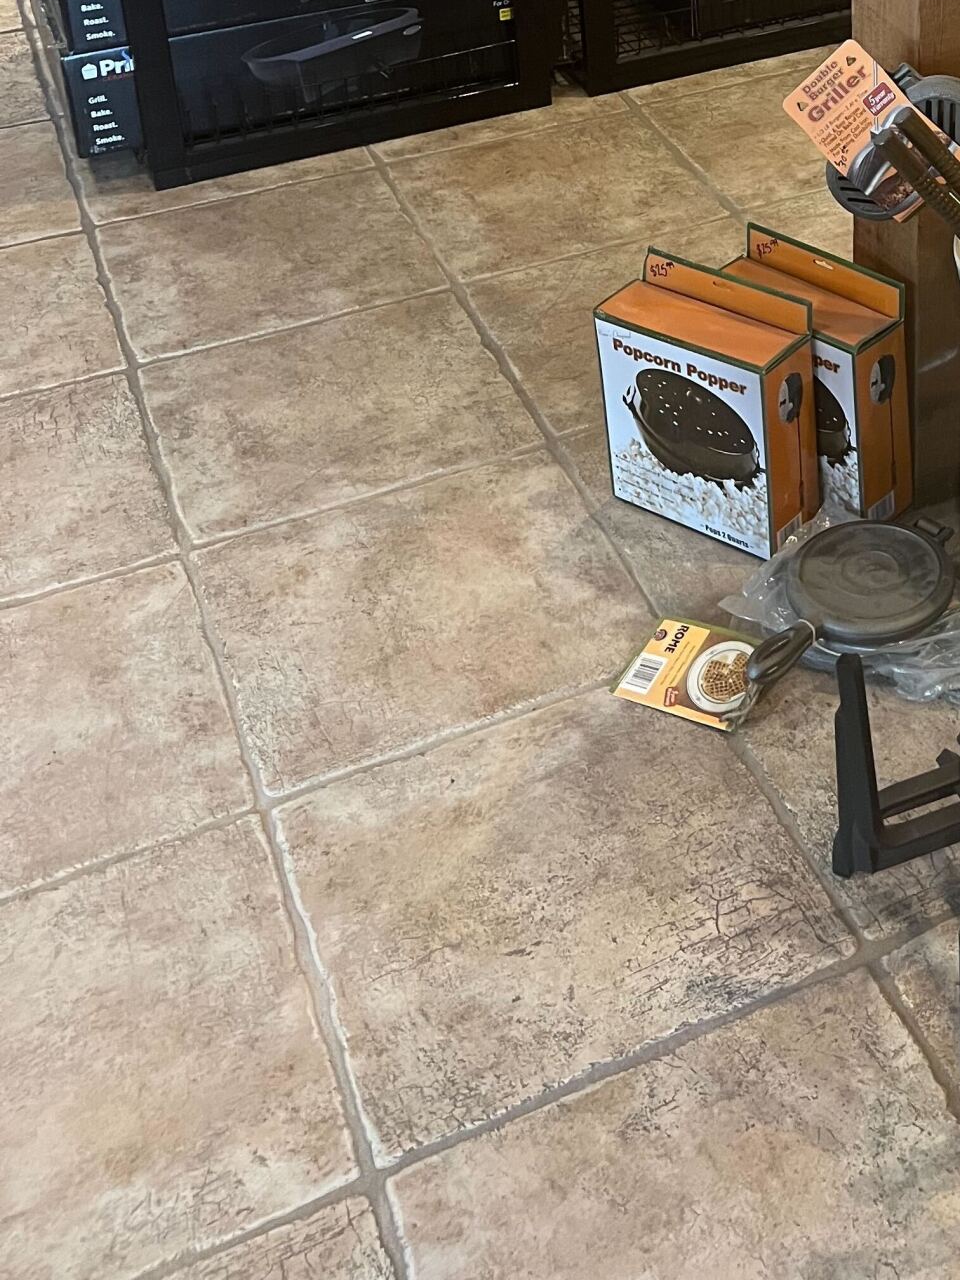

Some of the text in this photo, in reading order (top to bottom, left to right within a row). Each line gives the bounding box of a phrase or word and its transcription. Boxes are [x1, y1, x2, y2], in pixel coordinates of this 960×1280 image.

[80, 3, 104, 12] Bake.
[83, 17, 109, 27] Roast.
[86, 30, 116, 41] Smoke.
[802, 61, 838, 94] Double
[808, 68, 845, 101] Burger
[808, 66, 867, 122] Griller
[869, 94, 876, 105] 5
[88, 95, 108, 105] Grill.
[90, 109, 113, 118] Bake.
[93, 122, 119, 132] Roast.
[95, 134, 125, 145] Smoke.
[612, 338, 747, 396] Popcorn Popper
[705, 524, 721, 537] Pops
[726, 532, 749, 549] Quarts
[664, 624, 690, 654] ROME
